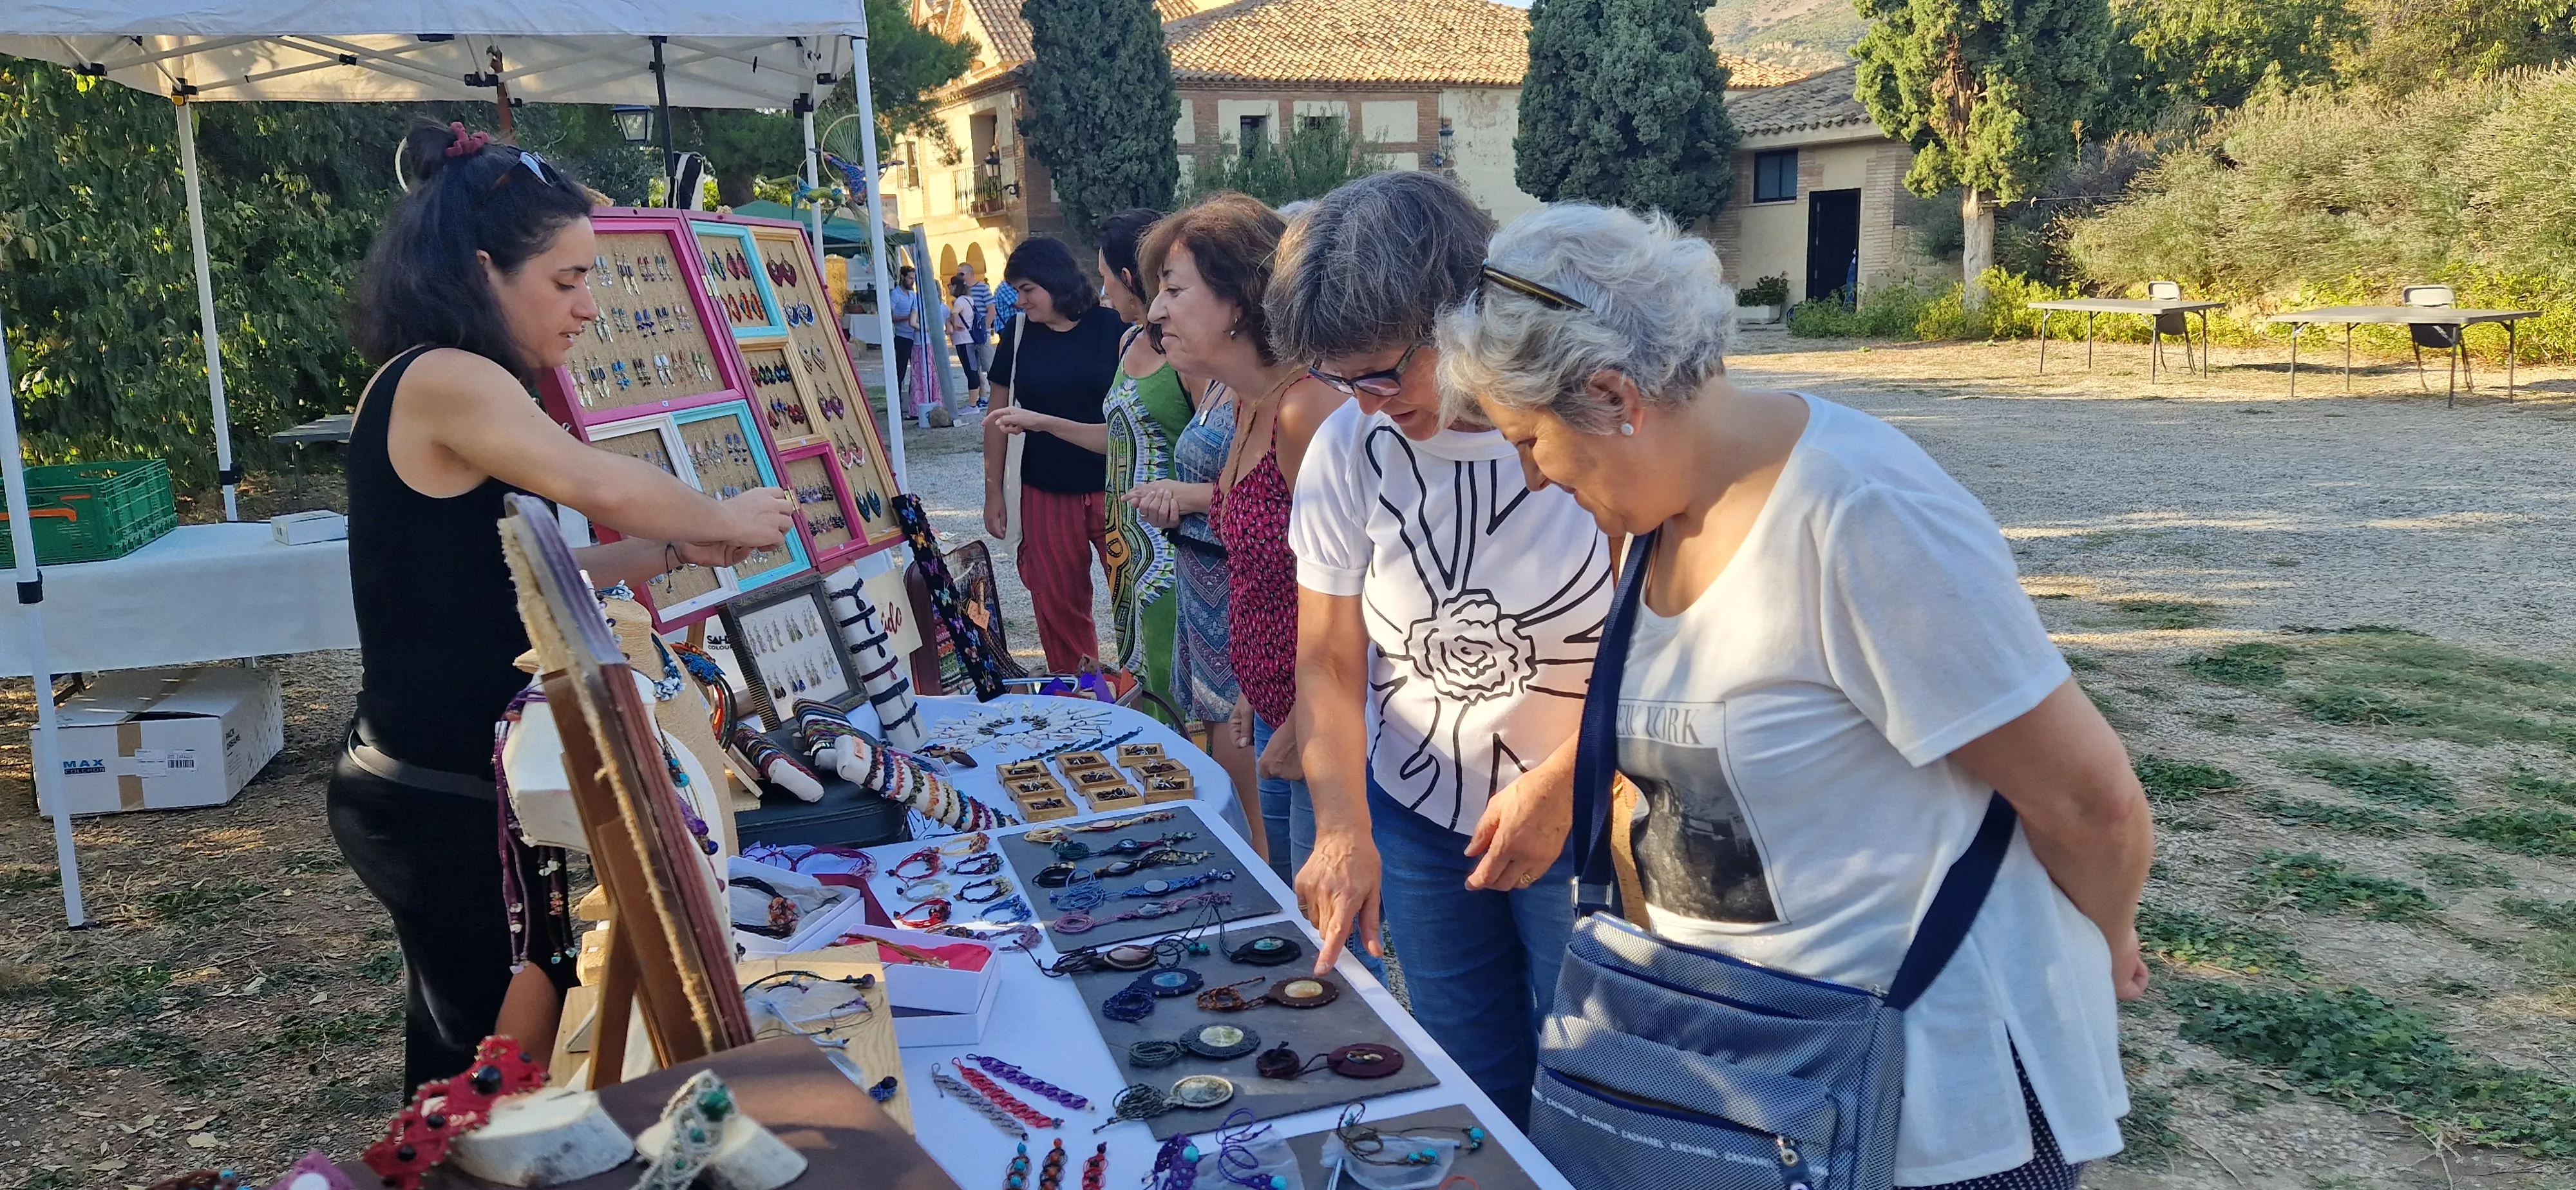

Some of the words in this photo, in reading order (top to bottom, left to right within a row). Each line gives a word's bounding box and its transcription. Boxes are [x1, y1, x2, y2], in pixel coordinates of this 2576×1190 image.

[1616, 704, 1640, 736] EW
[1645, 706, 1703, 745] YORK
[63, 759, 103, 768] MAX
[1621, 1129, 1665, 1149] CACHAREL
